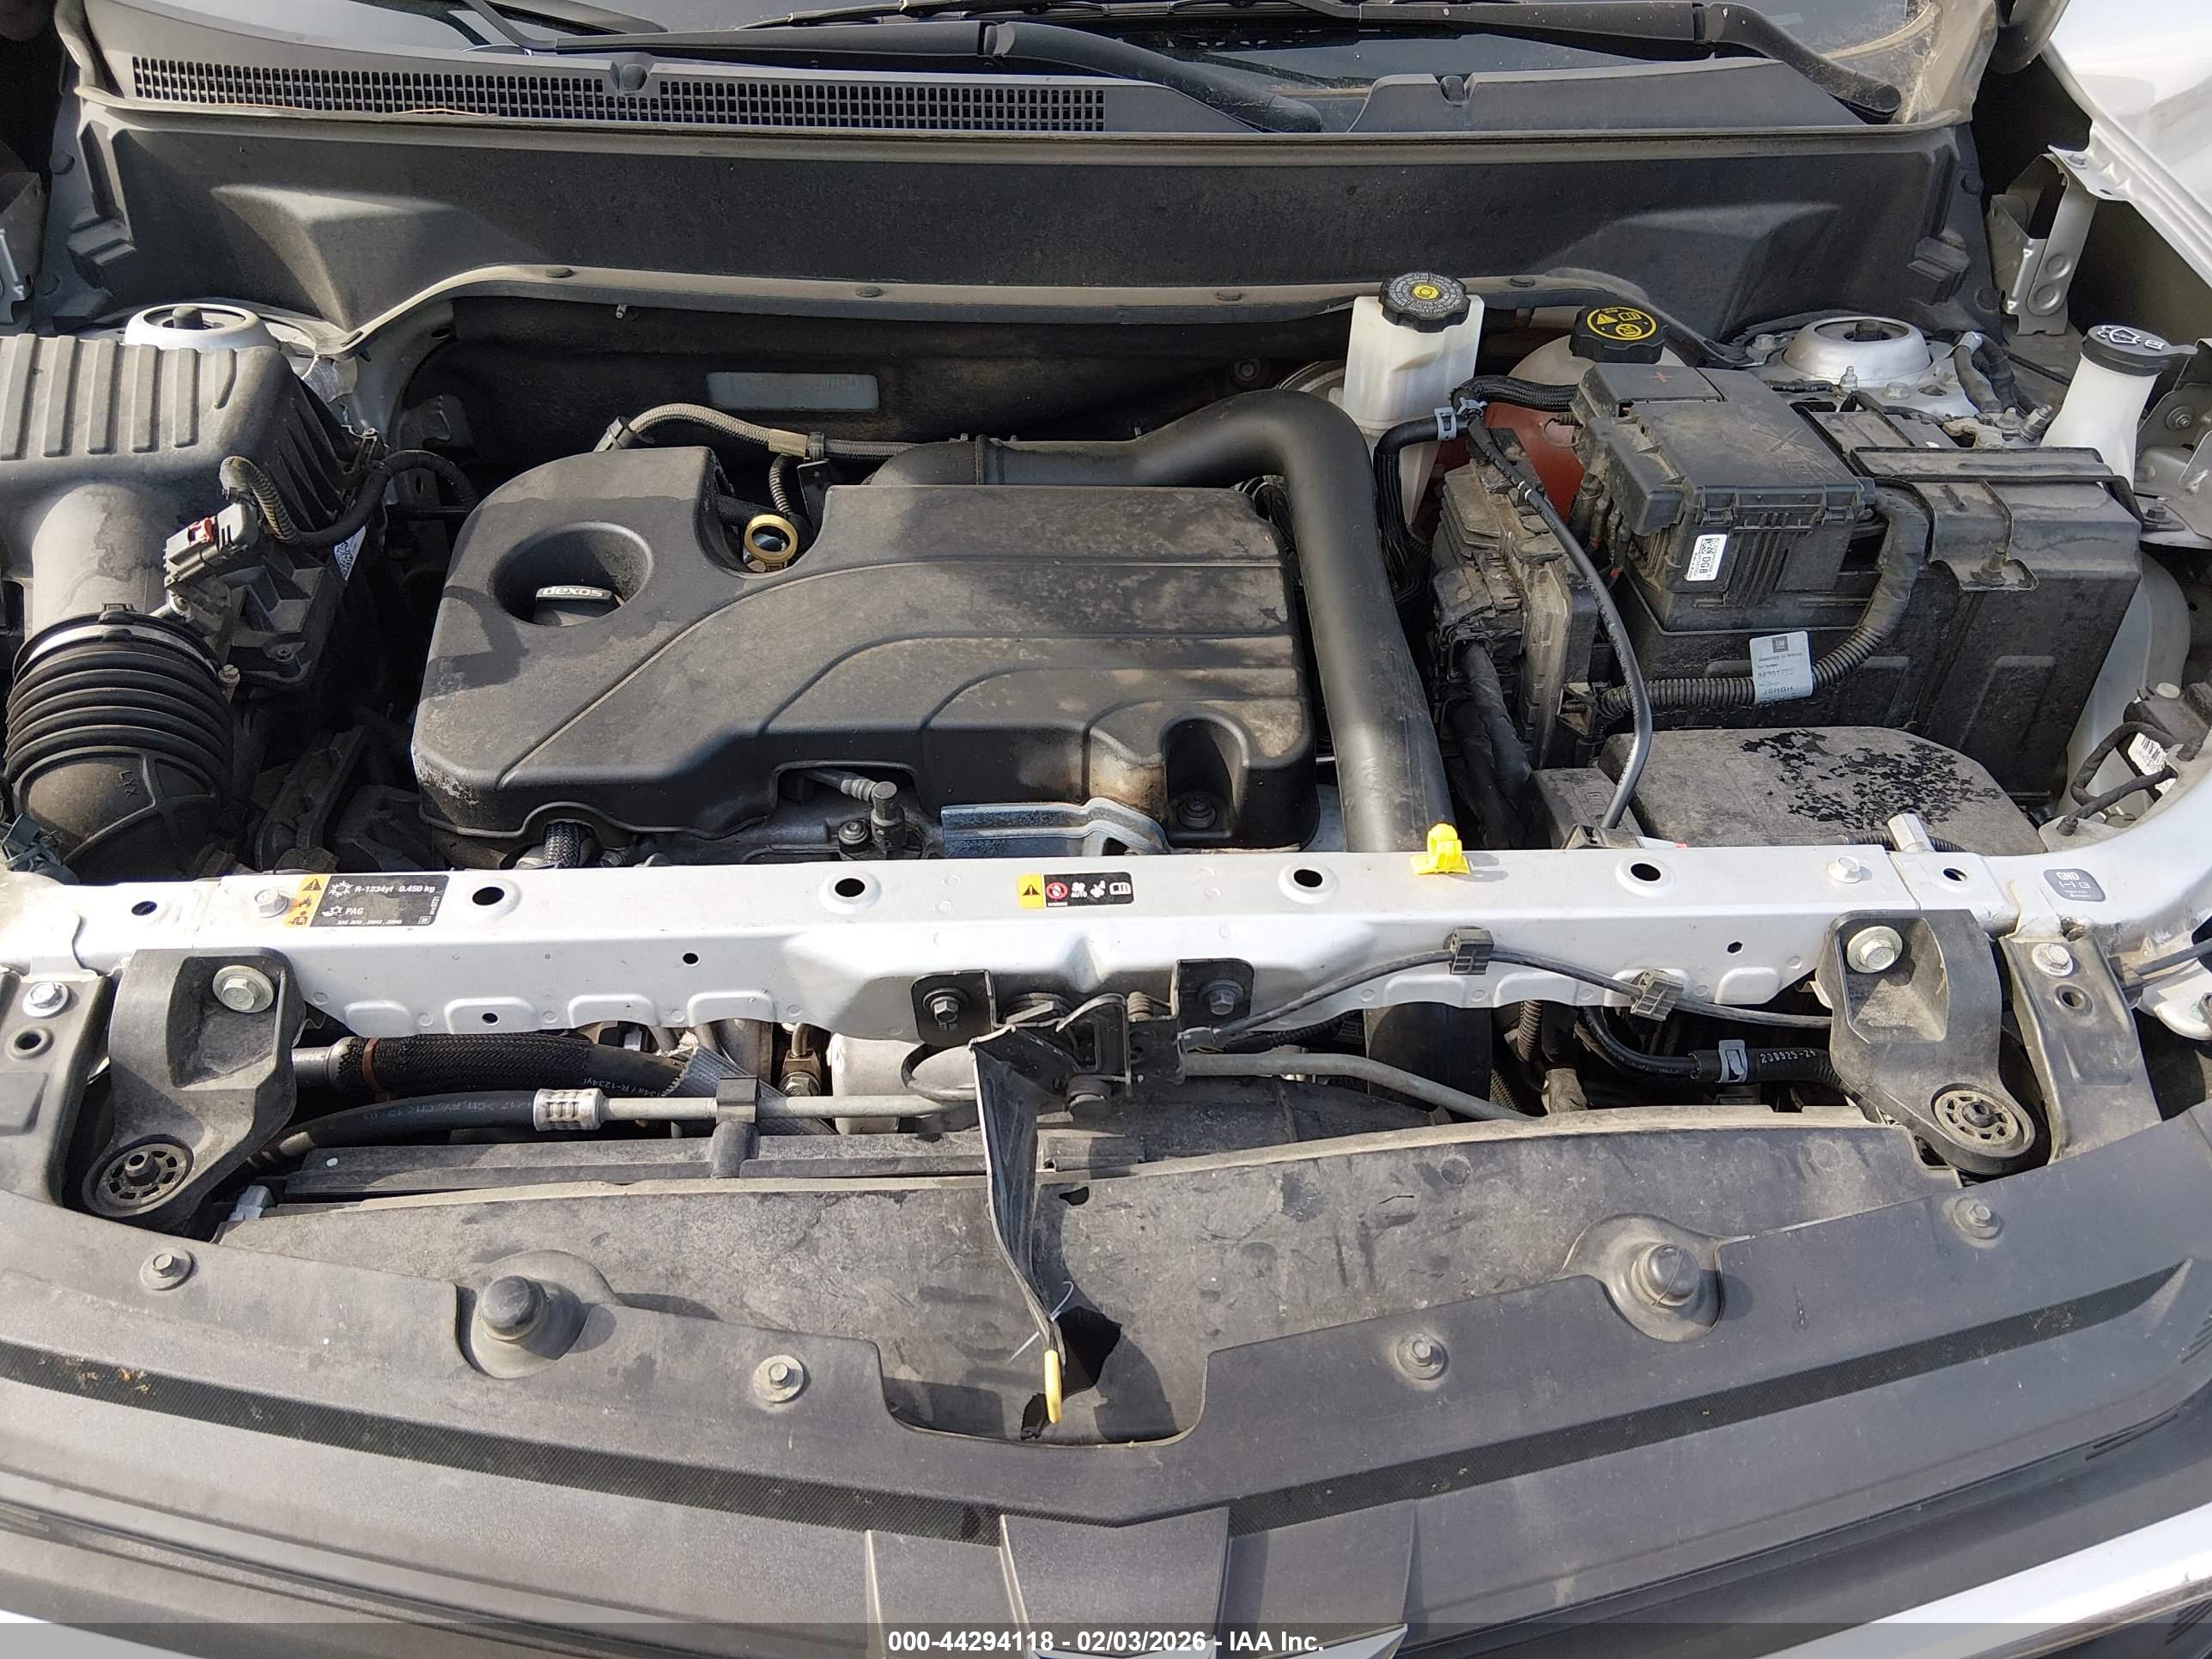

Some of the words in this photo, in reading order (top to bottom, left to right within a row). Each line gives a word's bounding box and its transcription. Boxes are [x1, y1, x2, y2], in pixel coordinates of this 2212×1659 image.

[1699, 556, 1711, 574] DGB
[542, 586, 604, 597] dexos
[2056, 872, 2080, 881] GND
[354, 885, 394, 894] R-1234yf
[423, 885, 436, 894] kg
[344, 907, 364, 915] PAG
